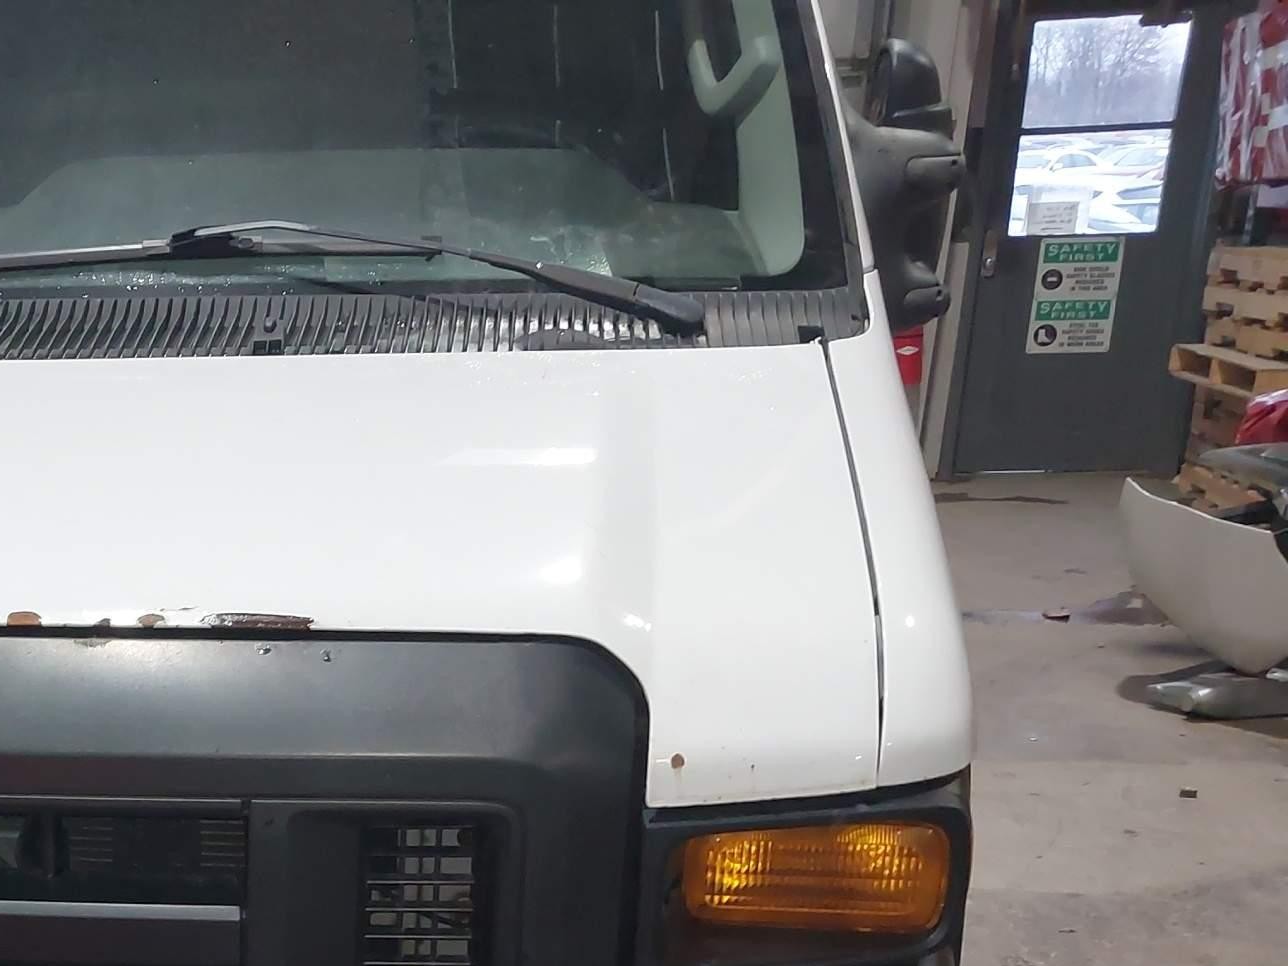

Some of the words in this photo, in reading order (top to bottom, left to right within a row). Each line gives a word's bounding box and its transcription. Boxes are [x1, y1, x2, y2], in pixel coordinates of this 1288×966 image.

[1047, 243, 1116, 257] SAFETY
[1058, 253, 1105, 262] FIRST
[1039, 301, 1109, 314] SAFETY
[1050, 311, 1097, 320] FIRST
